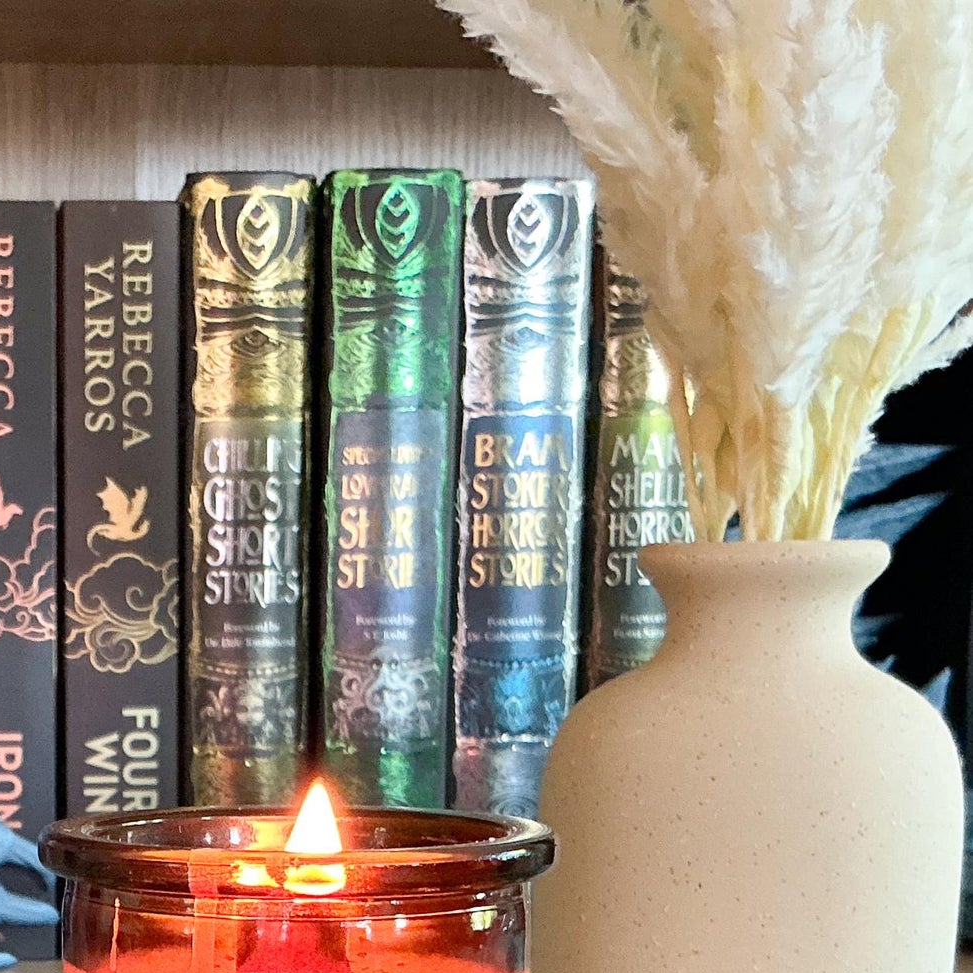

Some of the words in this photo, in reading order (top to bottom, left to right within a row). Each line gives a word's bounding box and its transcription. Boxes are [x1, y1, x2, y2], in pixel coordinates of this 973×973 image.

[83, 257, 116, 433] YARROS
[121, 240, 154, 450] REBECCA
[474, 432, 569, 471] BRAM
[204, 476, 301, 522] GHOST
[471, 471, 568, 511] STOKER
[608, 471, 689, 508] SHELLE
[205, 524, 299, 571] SHORT
[472, 511, 567, 551] HORROR
[204, 569, 300, 608] STORIES
[469, 551, 567, 591] STORIES
[82, 731, 121, 813] WIN
[121, 706, 160, 812] FOUR
